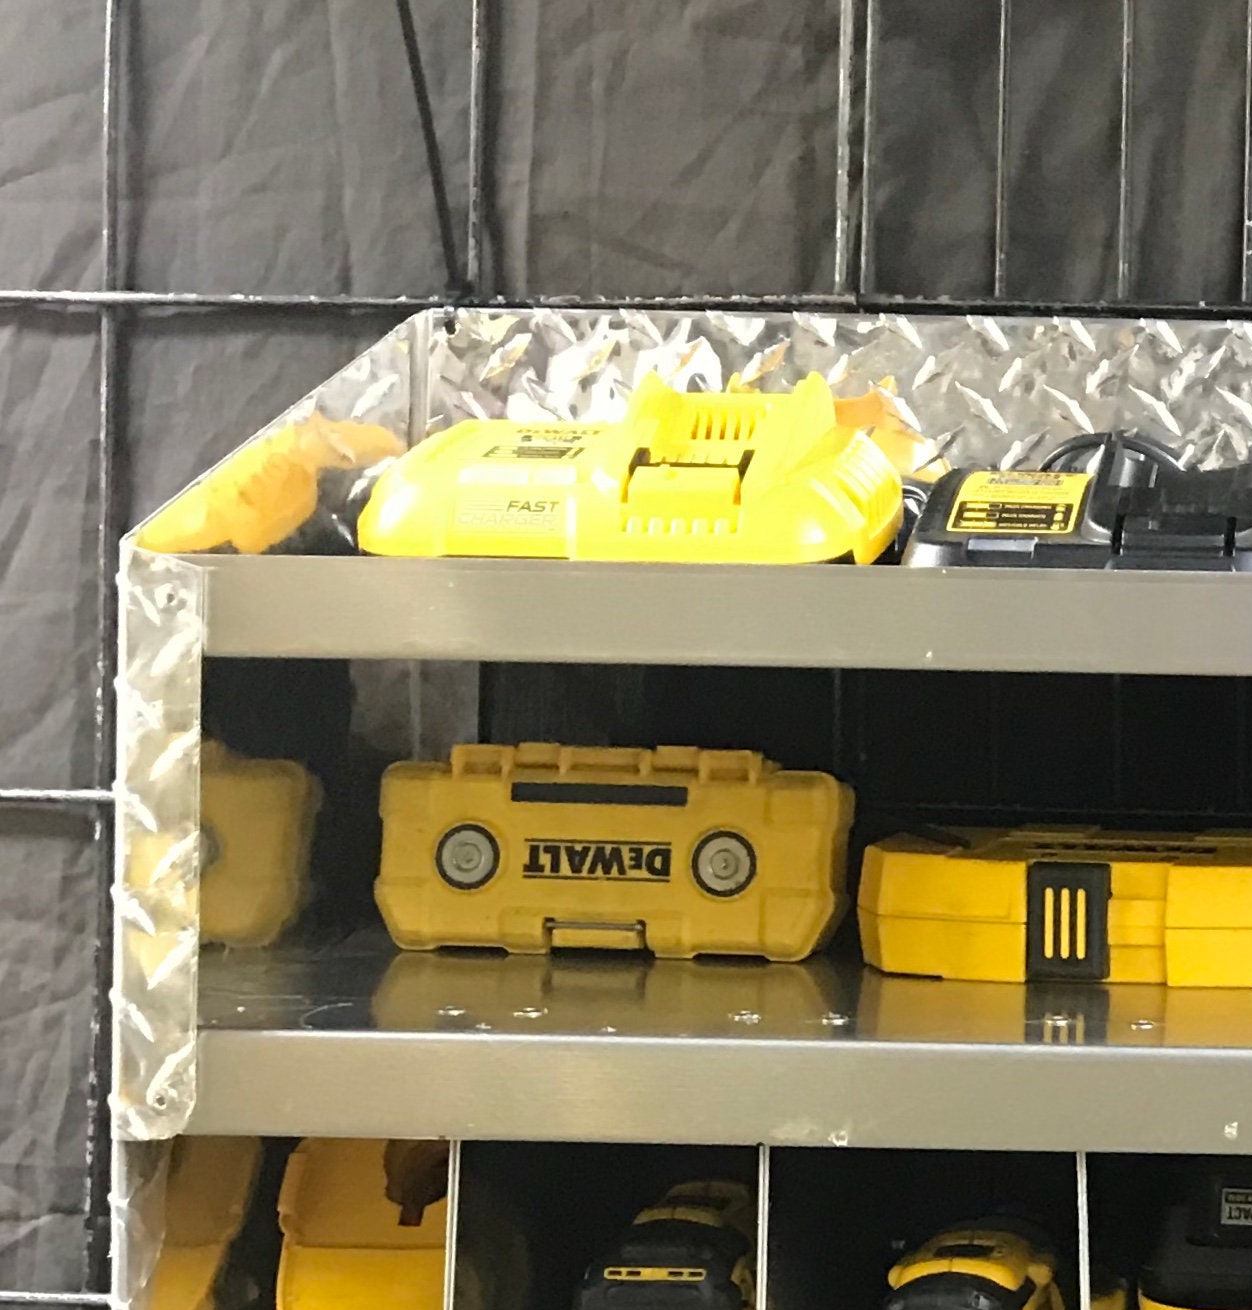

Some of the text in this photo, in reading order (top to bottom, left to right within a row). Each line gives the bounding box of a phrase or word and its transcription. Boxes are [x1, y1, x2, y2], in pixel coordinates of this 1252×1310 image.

[506, 501, 560, 512] FAST
[457, 514, 554, 525] CHARGER
[523, 844, 671, 876] DEWALT
